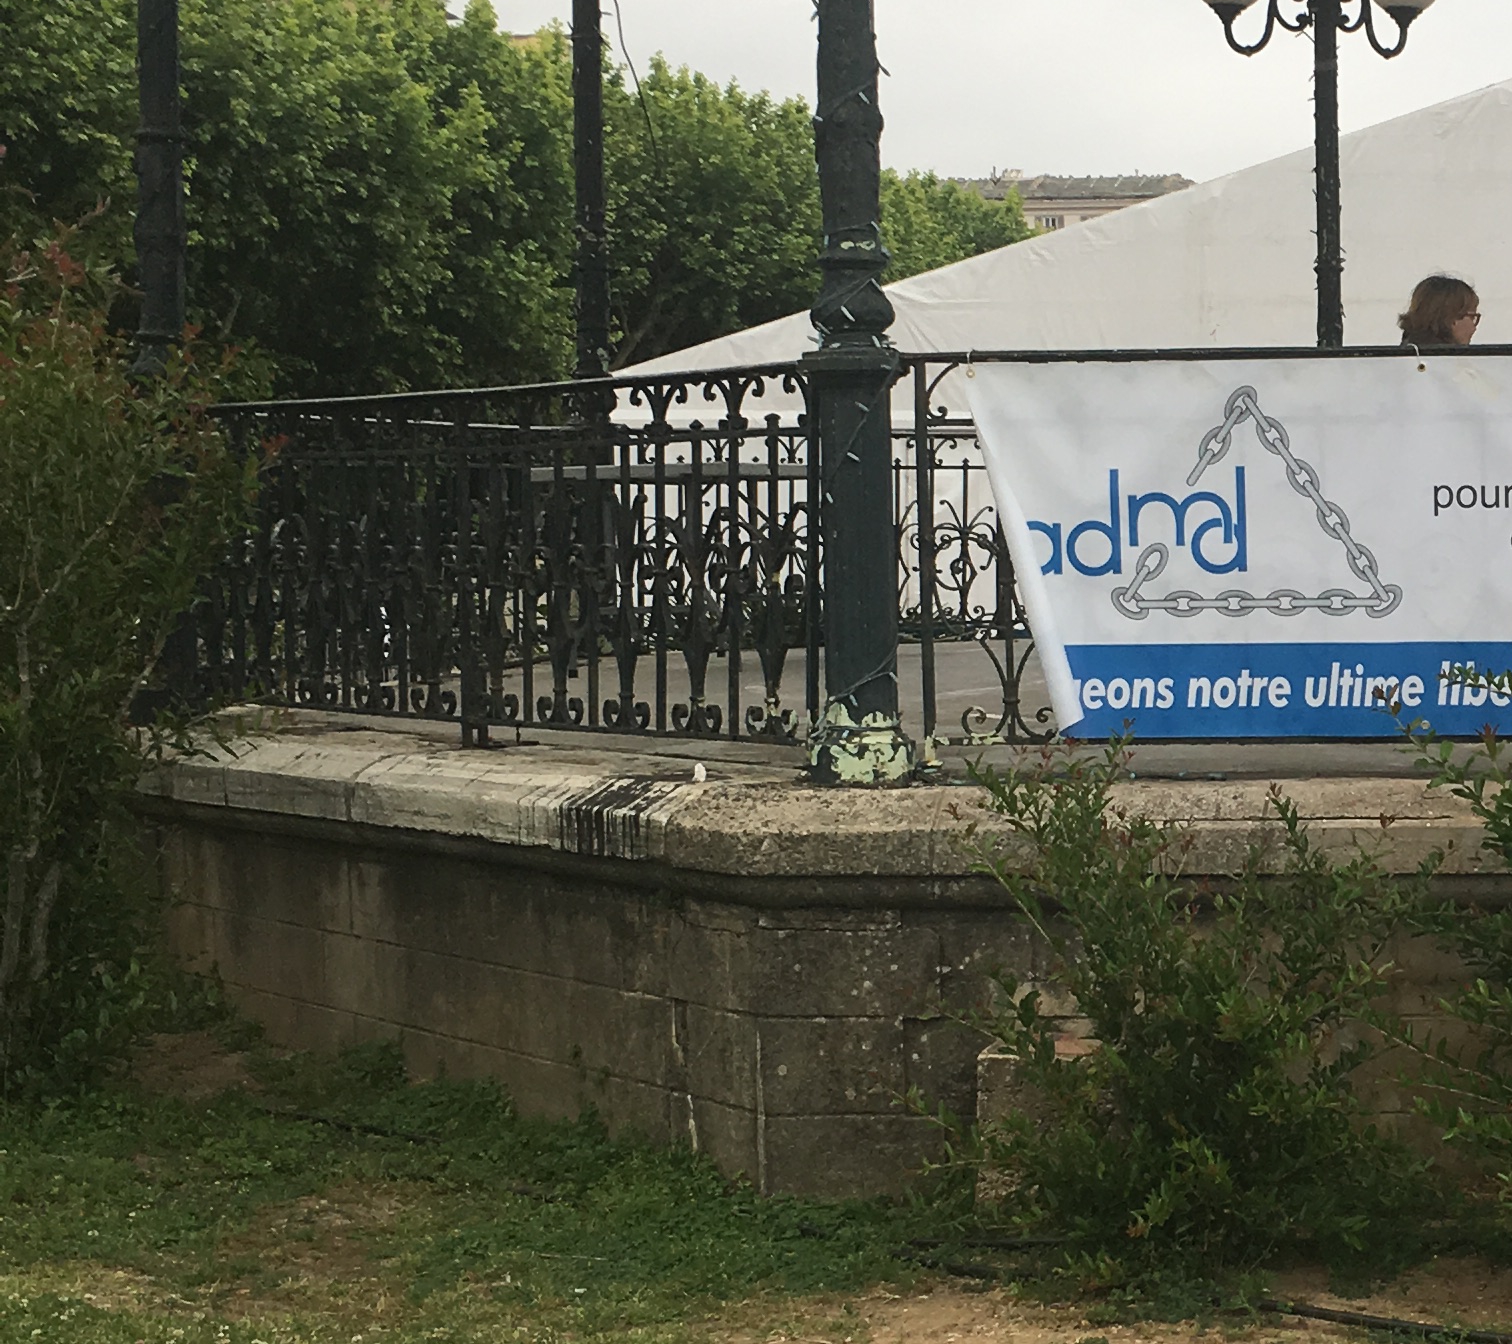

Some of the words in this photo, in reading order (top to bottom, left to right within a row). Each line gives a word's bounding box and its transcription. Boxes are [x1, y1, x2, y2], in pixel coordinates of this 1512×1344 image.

[1075, 676, 1174, 709] eons
[1187, 669, 1292, 708] notre
[1304, 661, 1425, 708] ultime
